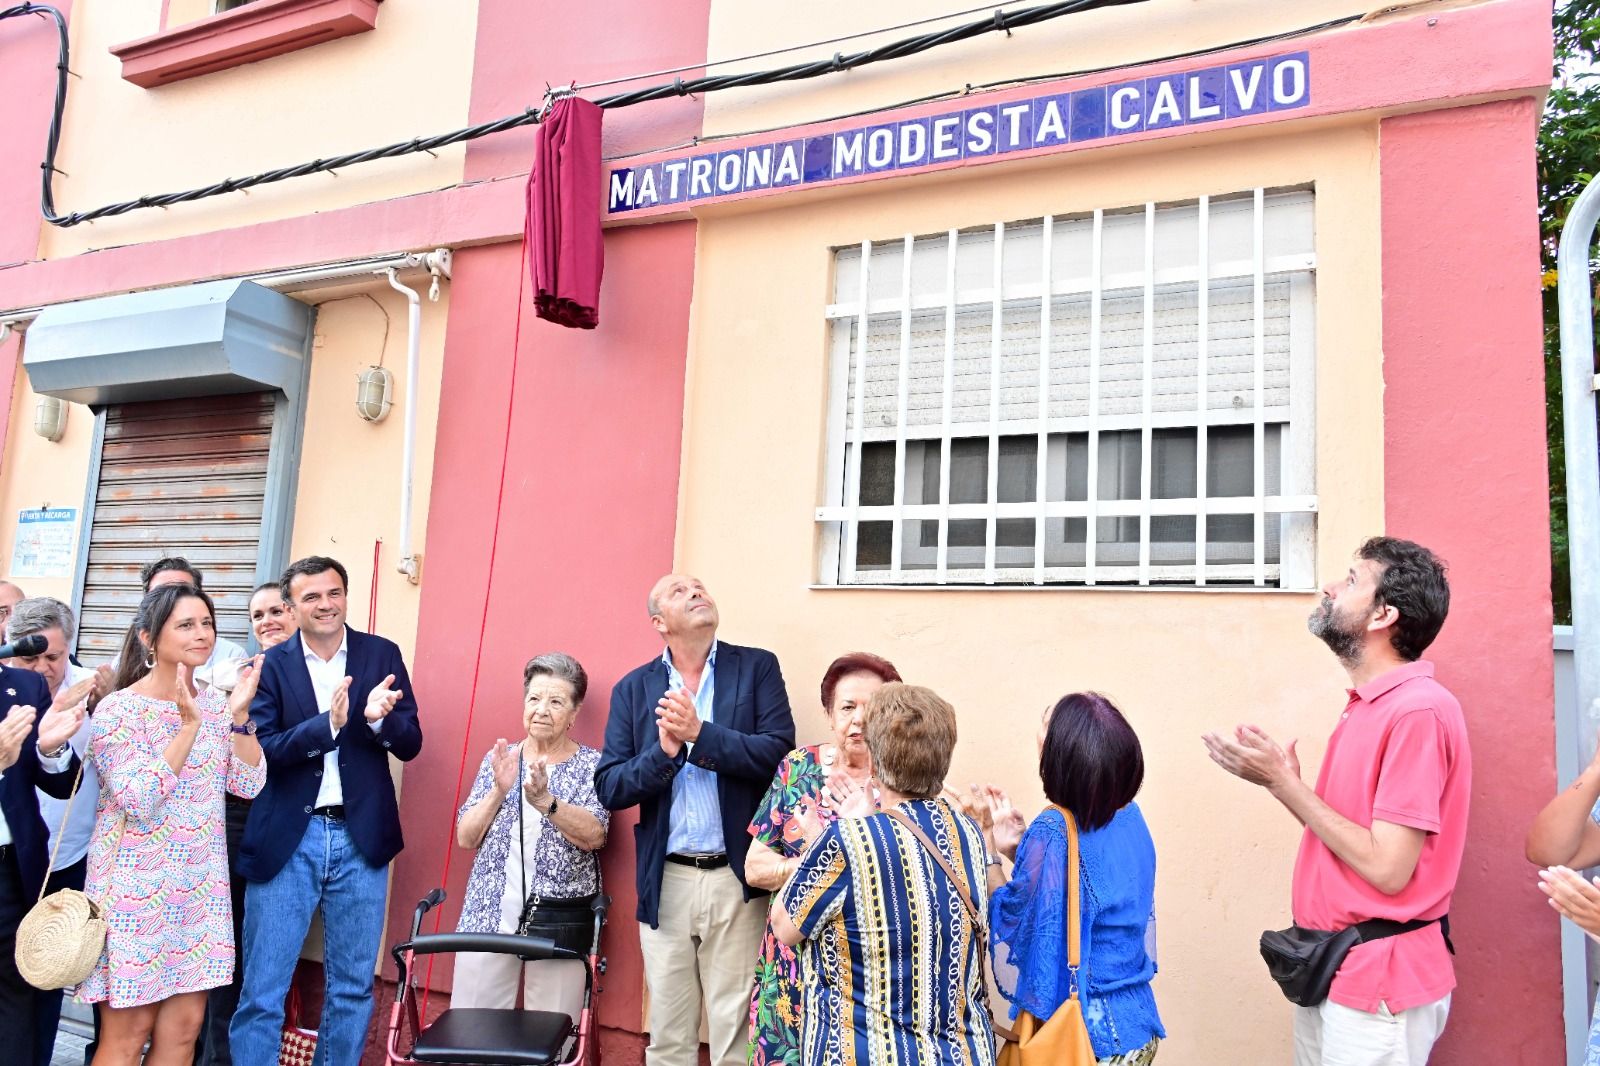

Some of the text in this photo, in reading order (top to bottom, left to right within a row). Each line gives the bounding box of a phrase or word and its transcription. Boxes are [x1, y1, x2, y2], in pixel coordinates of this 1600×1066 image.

[609, 59, 1306, 209] MATRONA MODESTA CALVO
